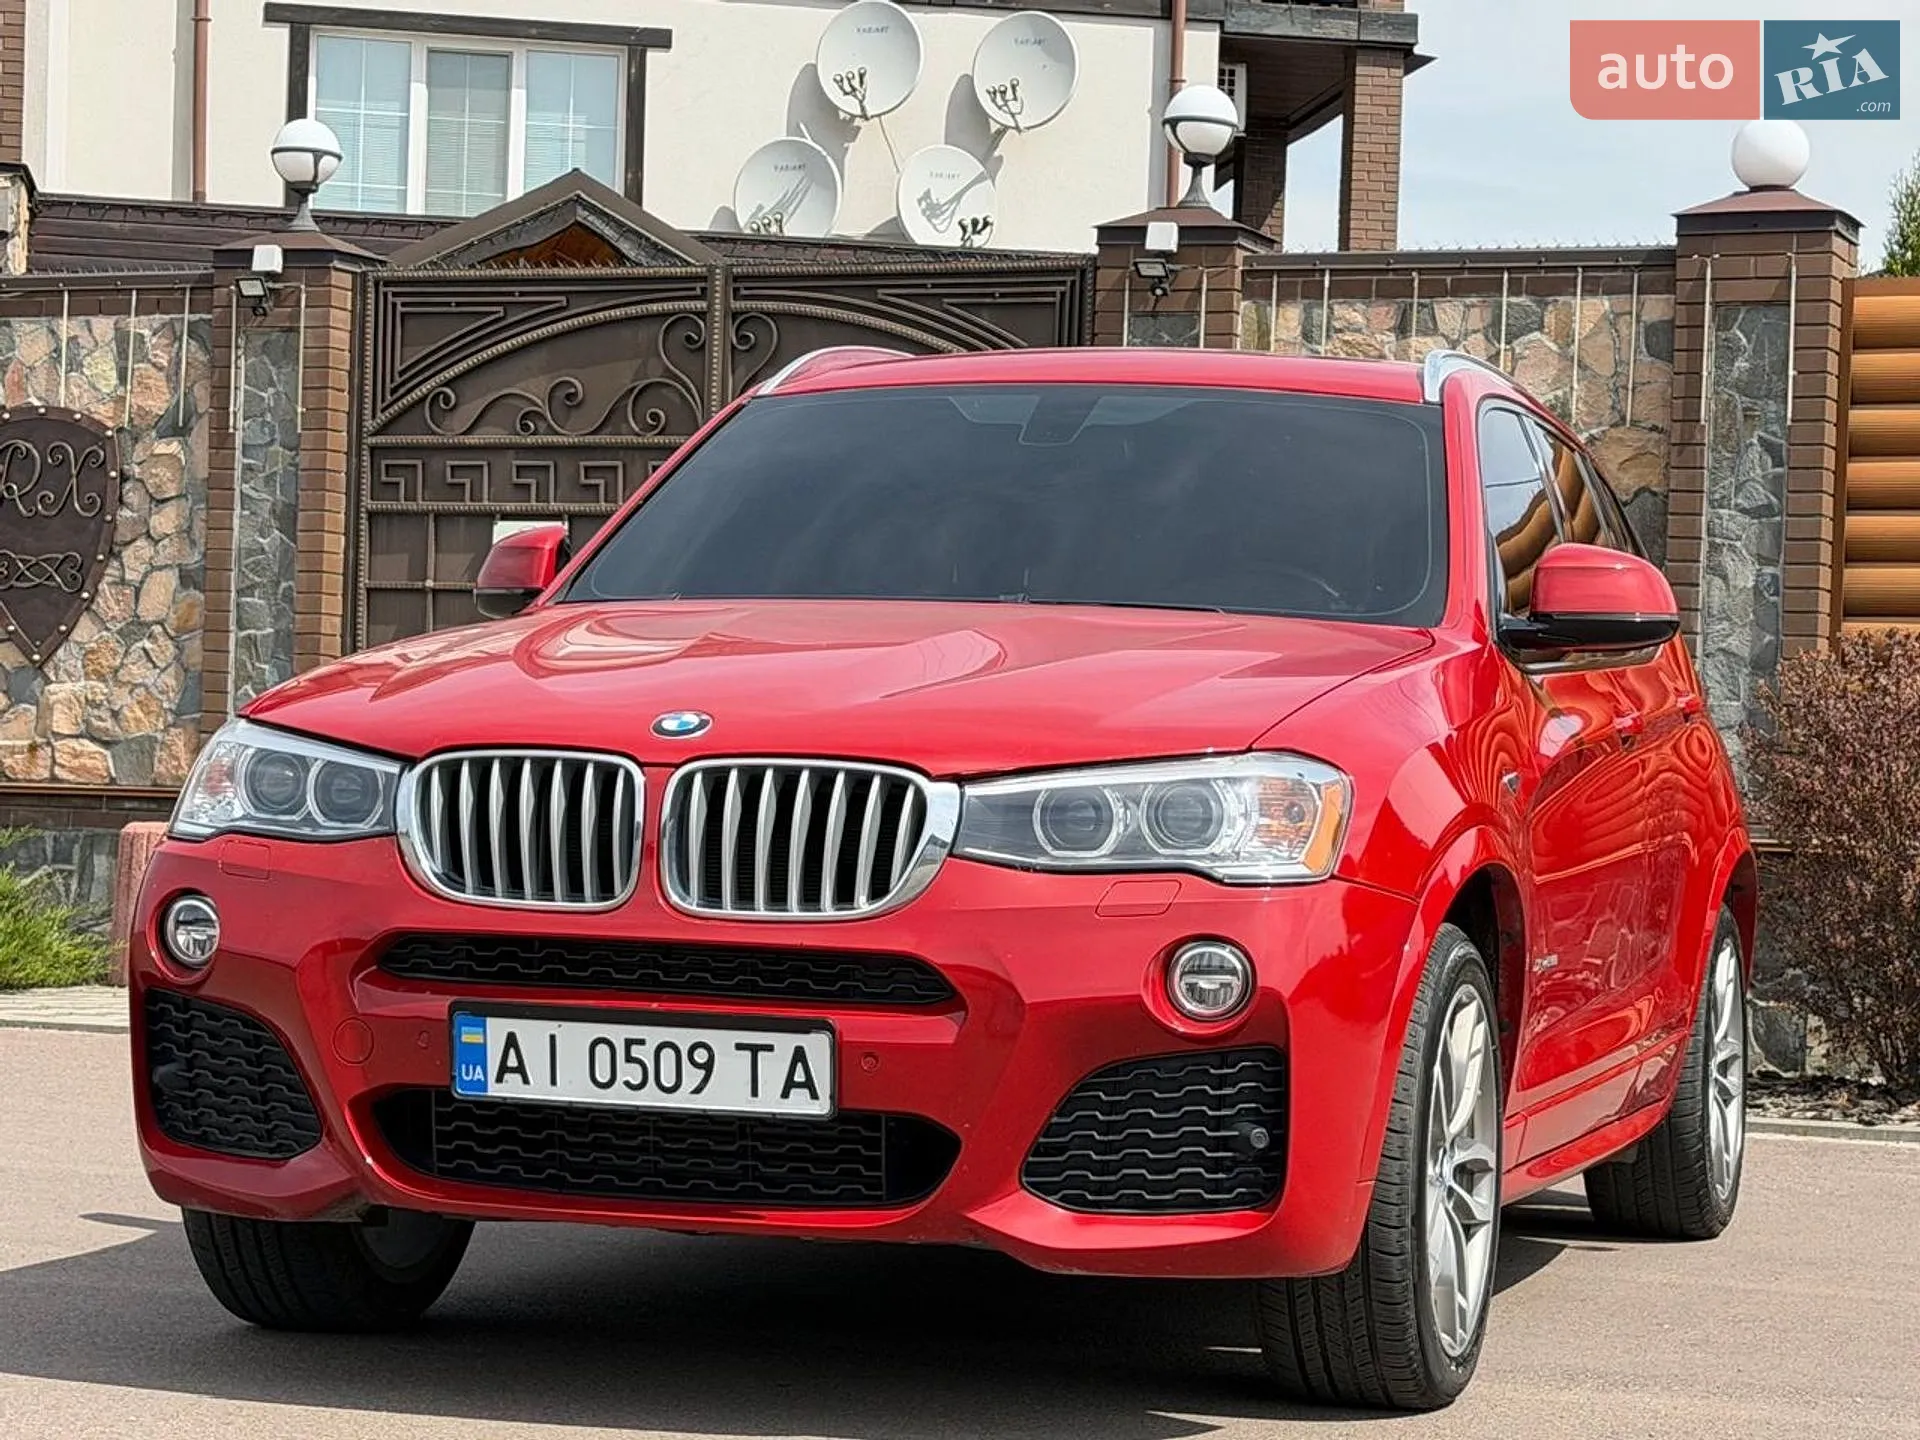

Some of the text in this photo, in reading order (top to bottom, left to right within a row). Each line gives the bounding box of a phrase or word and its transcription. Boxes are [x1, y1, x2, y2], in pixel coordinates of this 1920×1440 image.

[461, 1066, 485, 1082] UA
[494, 1031, 820, 1101] AI 0509 TA
